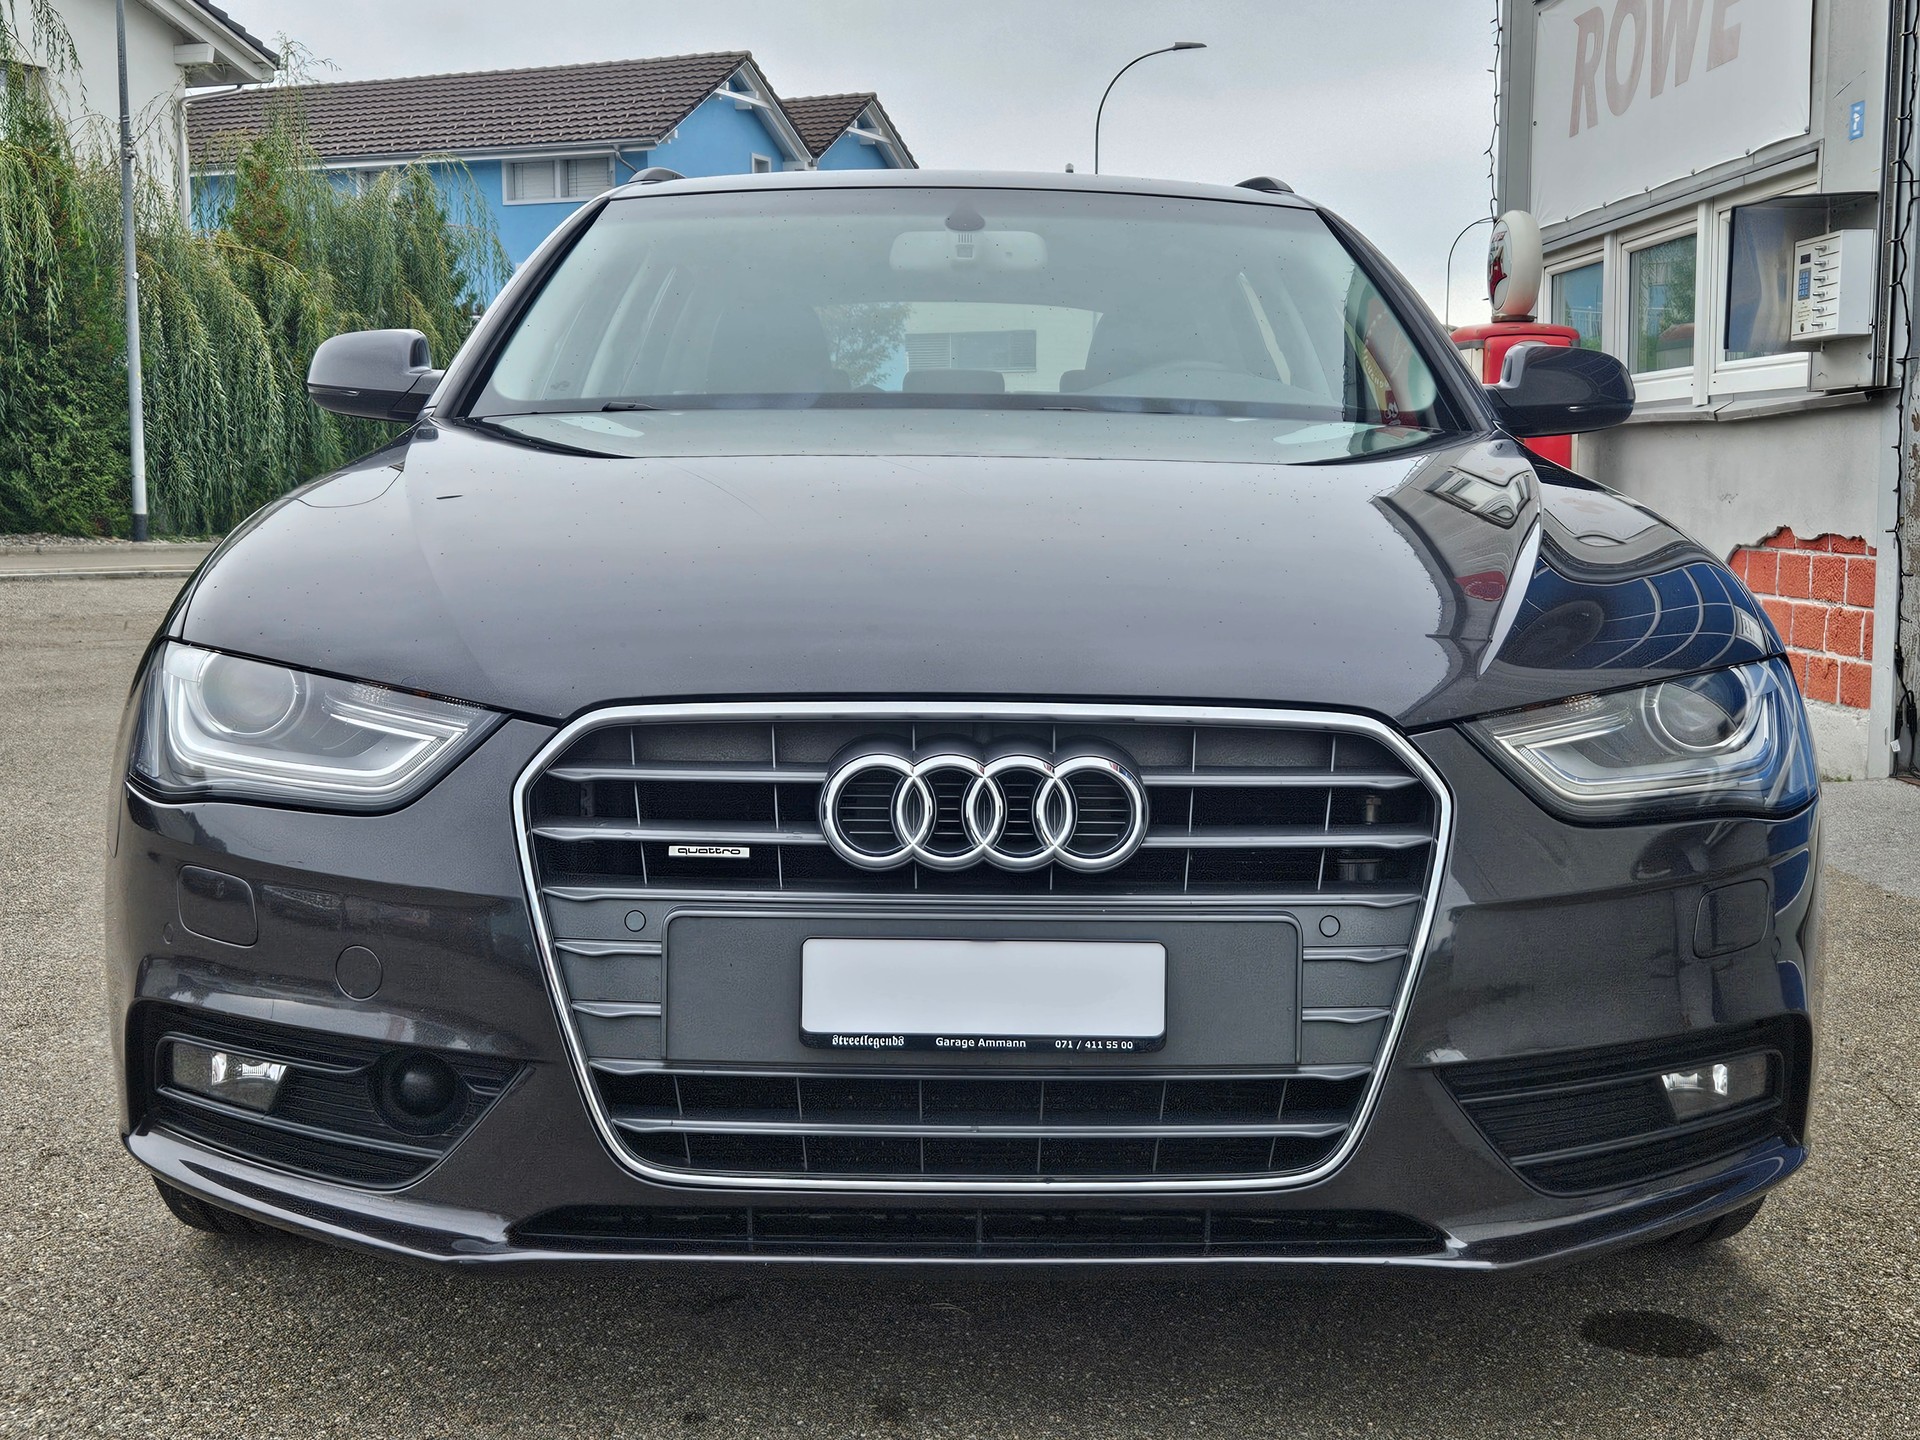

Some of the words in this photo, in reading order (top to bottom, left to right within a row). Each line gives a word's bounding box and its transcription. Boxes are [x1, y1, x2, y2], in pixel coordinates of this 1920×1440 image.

[677, 847, 741, 856] quattro
[935, 1036, 975, 1049] Garage
[977, 1037, 1027, 1048] Ammann
[1055, 1039, 1073, 1049] 071
[1076, 1039, 1082, 1050] /
[1084, 1039, 1103, 1049] 411
[1106, 1039, 1118, 1049] 55
[1120, 1039, 1134, 1049] 00
